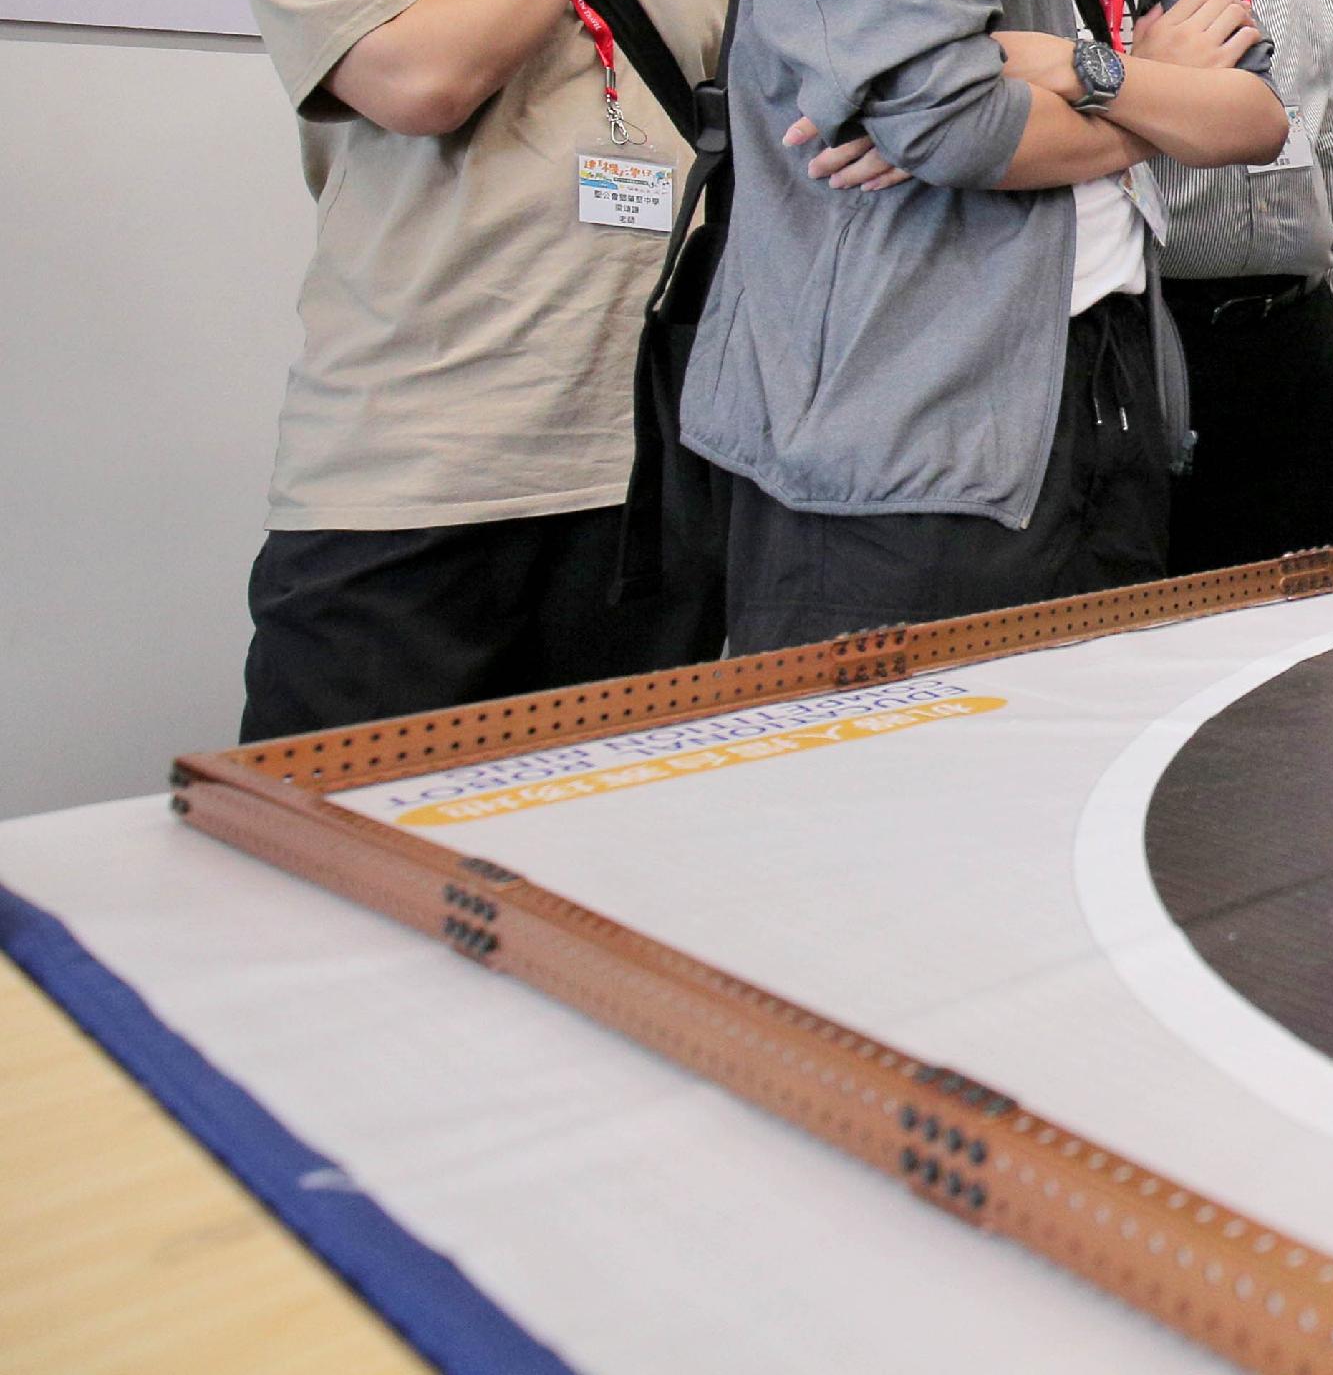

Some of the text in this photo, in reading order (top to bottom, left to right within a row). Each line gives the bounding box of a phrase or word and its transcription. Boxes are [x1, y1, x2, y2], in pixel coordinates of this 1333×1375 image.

[388, 682, 971, 810] EDUCATIONAL ROBOT
[443, 745, 591, 780] RING
